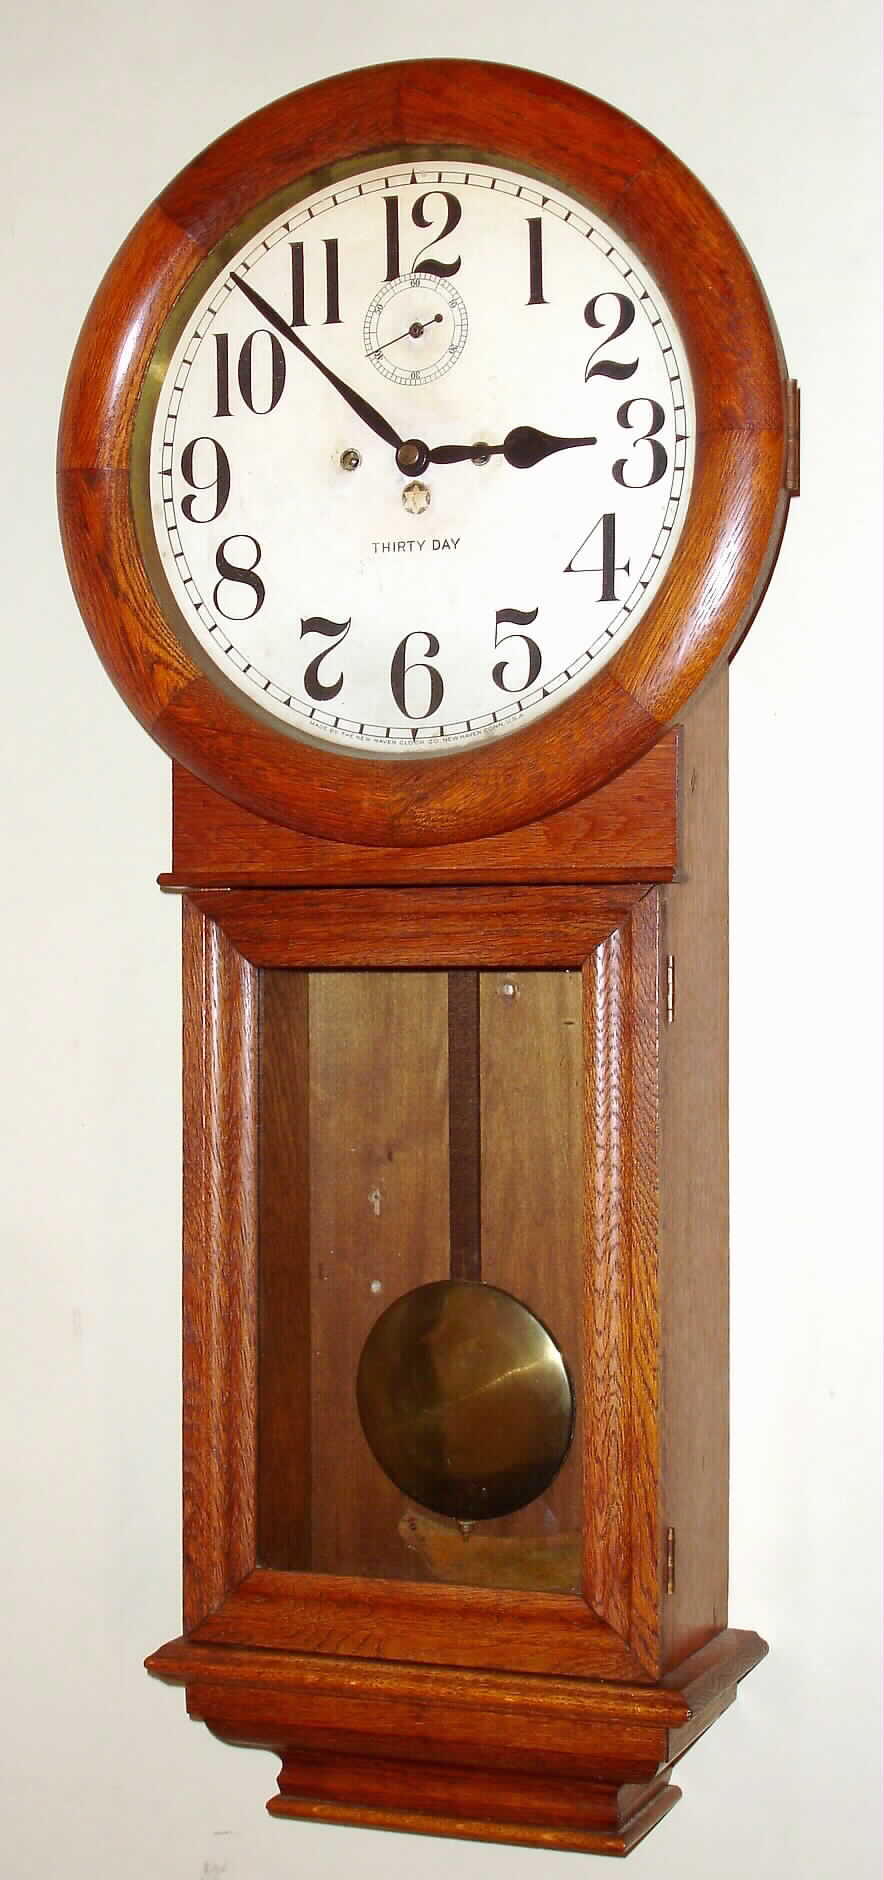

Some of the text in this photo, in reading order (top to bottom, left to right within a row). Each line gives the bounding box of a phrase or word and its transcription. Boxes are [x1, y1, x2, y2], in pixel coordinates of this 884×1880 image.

[383, 190, 462, 282] 12
[525, 216, 550, 306] 1
[288, 237, 345, 328] 11
[211, 328, 287, 418] 10
[583, 291, 640, 384] 2
[180, 436, 231, 524] 9
[611, 397, 669, 490] 3
[212, 534, 266, 621] 8
[371, 538, 461, 553] THIRTY DAY
[563, 512, 631, 603] 4
[299, 616, 352, 702] 7
[390, 631, 445, 720] 6
[491, 606, 543, 693] 5
[459, 730, 482, 740] HAVEN
